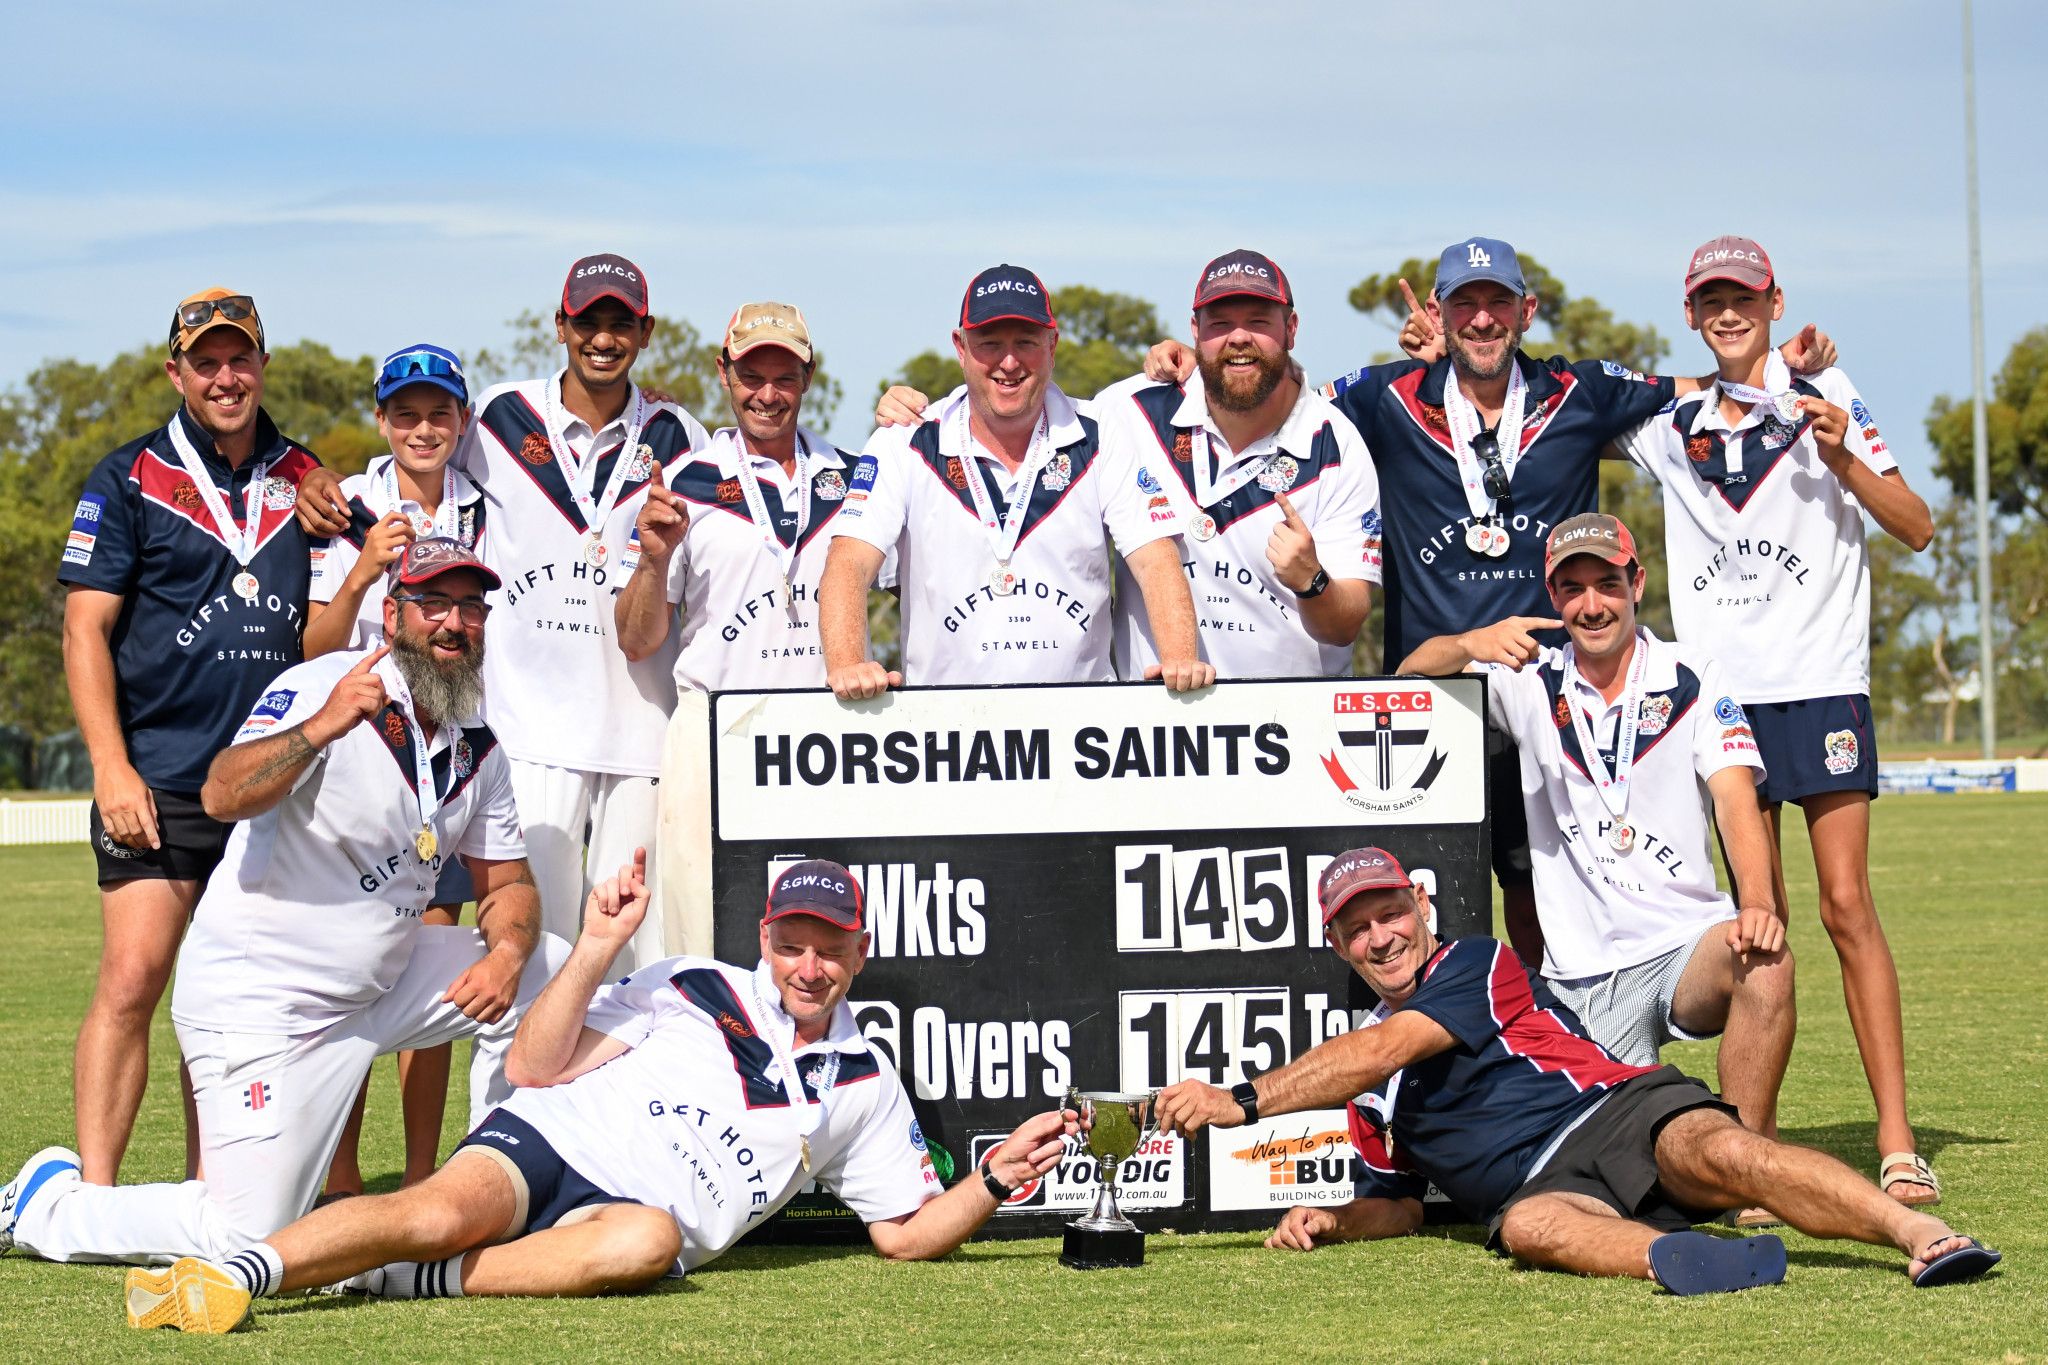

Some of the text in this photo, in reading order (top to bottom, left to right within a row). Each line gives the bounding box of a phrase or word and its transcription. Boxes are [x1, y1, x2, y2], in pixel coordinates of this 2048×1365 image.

[1467, 243, 1491, 268] LA
[1419, 516, 1473, 565] GIFT
[507, 563, 555, 606] GIFT
[1458, 569, 1536, 582] STAWELL
[1694, 539, 1809, 591] GIFT HOTEL
[176, 595, 229, 646] GIFT
[565, 598, 587, 606] 3380
[721, 590, 775, 642] GIFT
[943, 578, 1091, 633] GIFT HOTEL
[536, 620, 606, 636] STAWELL
[982, 640, 1059, 651] STAWELL
[1200, 619, 1256, 632] AWELL
[217, 650, 287, 662] STAWELL
[761, 646, 824, 659] STAWEL
[754, 723, 1291, 787] HORSHAM SAINTS
[1346, 793, 1424, 812] HORSHAM SAINTS
[848, 862, 986, 958] Wkts
[1124, 852, 1290, 943] 145
[913, 1006, 1072, 1100] Overs
[1130, 998, 1286, 1088] 145
[1251, 1130, 1287, 1168] Way
[1292, 1127, 1315, 1153] to
[672, 1142, 725, 1208] STAWELL
[720, 1126, 768, 1223] HOTEL
[1121, 1160, 1171, 1183] DIG
[786, 1208, 833, 1218] Horsham
[1269, 1190, 1326, 1202] BUILDING
